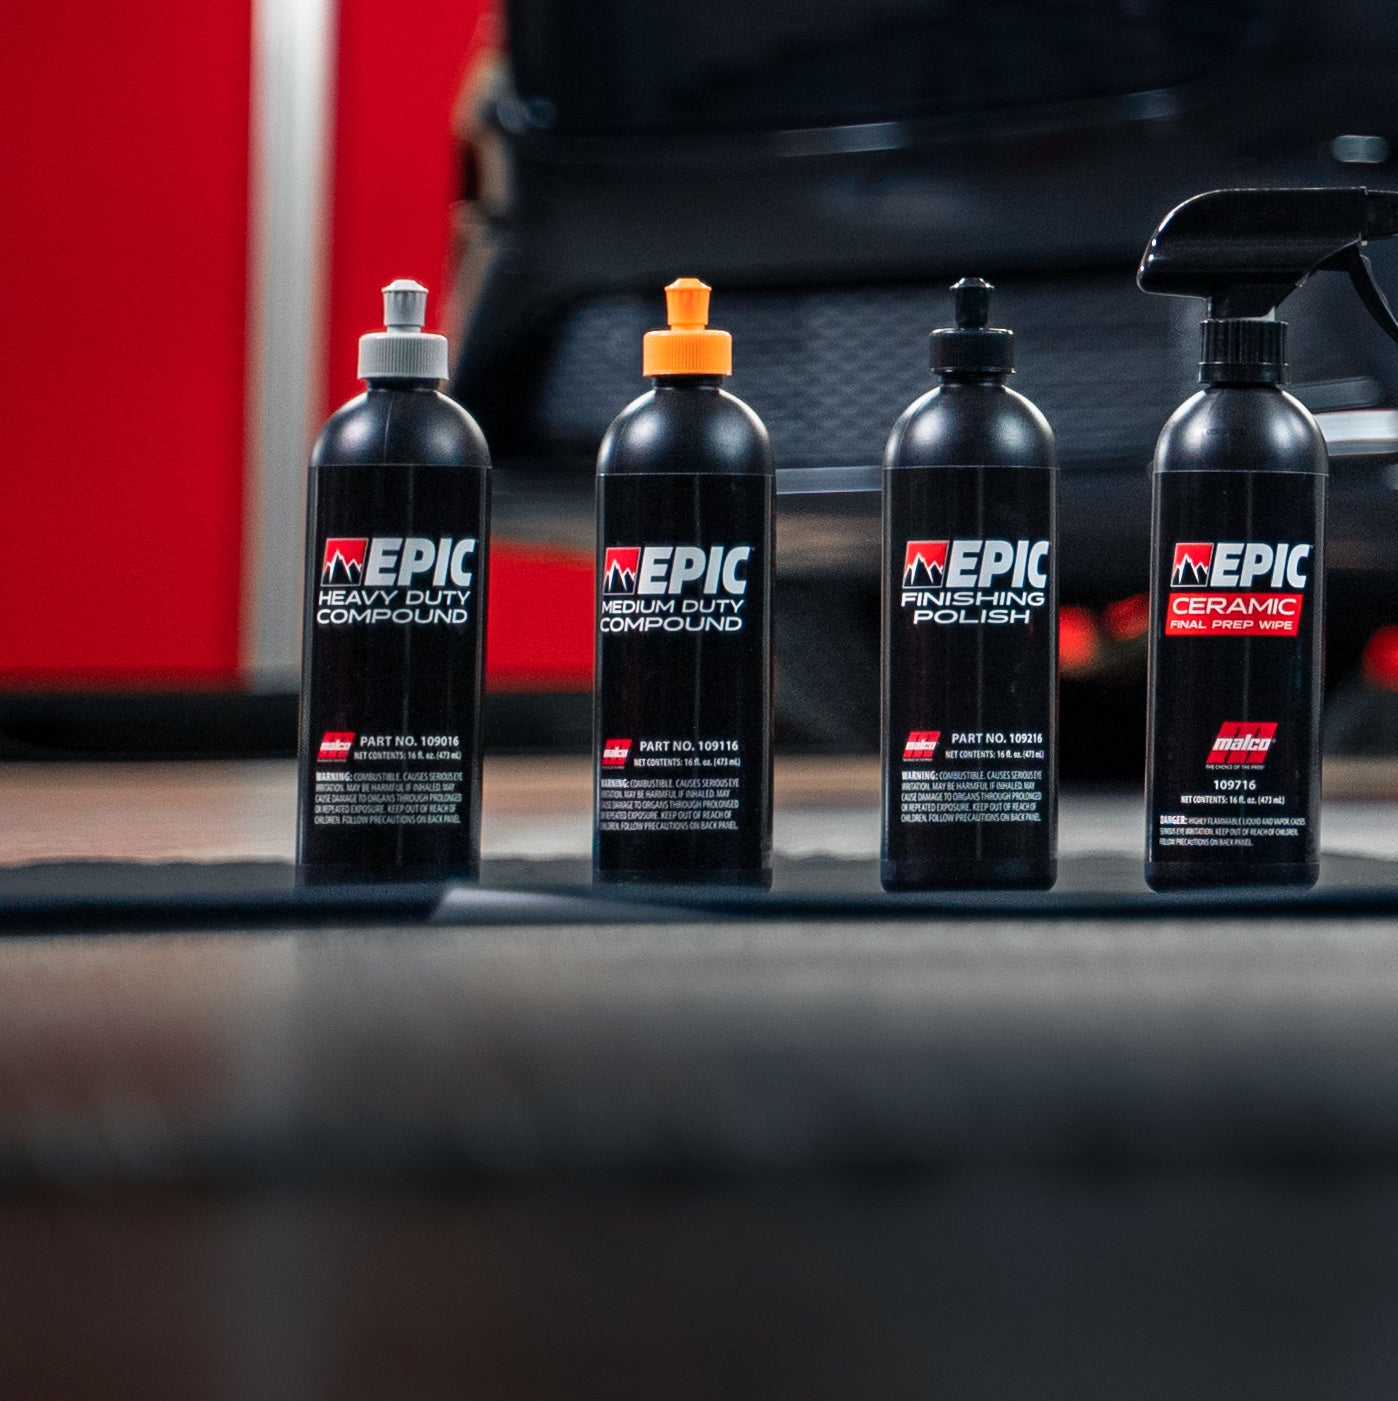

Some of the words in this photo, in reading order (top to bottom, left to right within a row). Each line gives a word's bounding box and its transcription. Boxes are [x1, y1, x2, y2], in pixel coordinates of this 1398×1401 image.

[364, 538, 475, 586] EPIC
[946, 540, 1050, 588] EPIC
[1210, 543, 1310, 587] EPIC
[637, 547, 750, 594] EPIC
[319, 591, 398, 605] HEAVY
[406, 591, 470, 605] DUTY
[901, 592, 1045, 606] FINISHING
[602, 600, 675, 614] MEDIUM
[681, 600, 744, 614] DUTY
[1173, 598, 1297, 615] CERAMIC
[317, 609, 467, 624] COMPOUND
[913, 610, 1030, 624] POLISH
[600, 617, 742, 632] COMPOUND
[1170, 620, 1207, 630] FINAL
[1212, 620, 1253, 630] PREP
[1259, 620, 1293, 630] WIPE
[360, 736, 392, 746] PART
[395, 736, 417, 746] NO.
[421, 736, 459, 746] 109016
[906, 739, 936, 750] malco
[952, 733, 982, 743] PART
[986, 733, 1006, 743] NO.
[1010, 733, 1042, 743] 109216
[1212, 734, 1272, 751] malco
[640, 741, 670, 751] PART
[673, 741, 694, 751] NO.
[699, 741, 738, 751] 109116
[354, 752, 366, 760] NET
[408, 752, 416, 760] 16
[946, 751, 957, 759] NET
[997, 751, 1004, 759] 16
[1214, 780, 1256, 790] 109716
